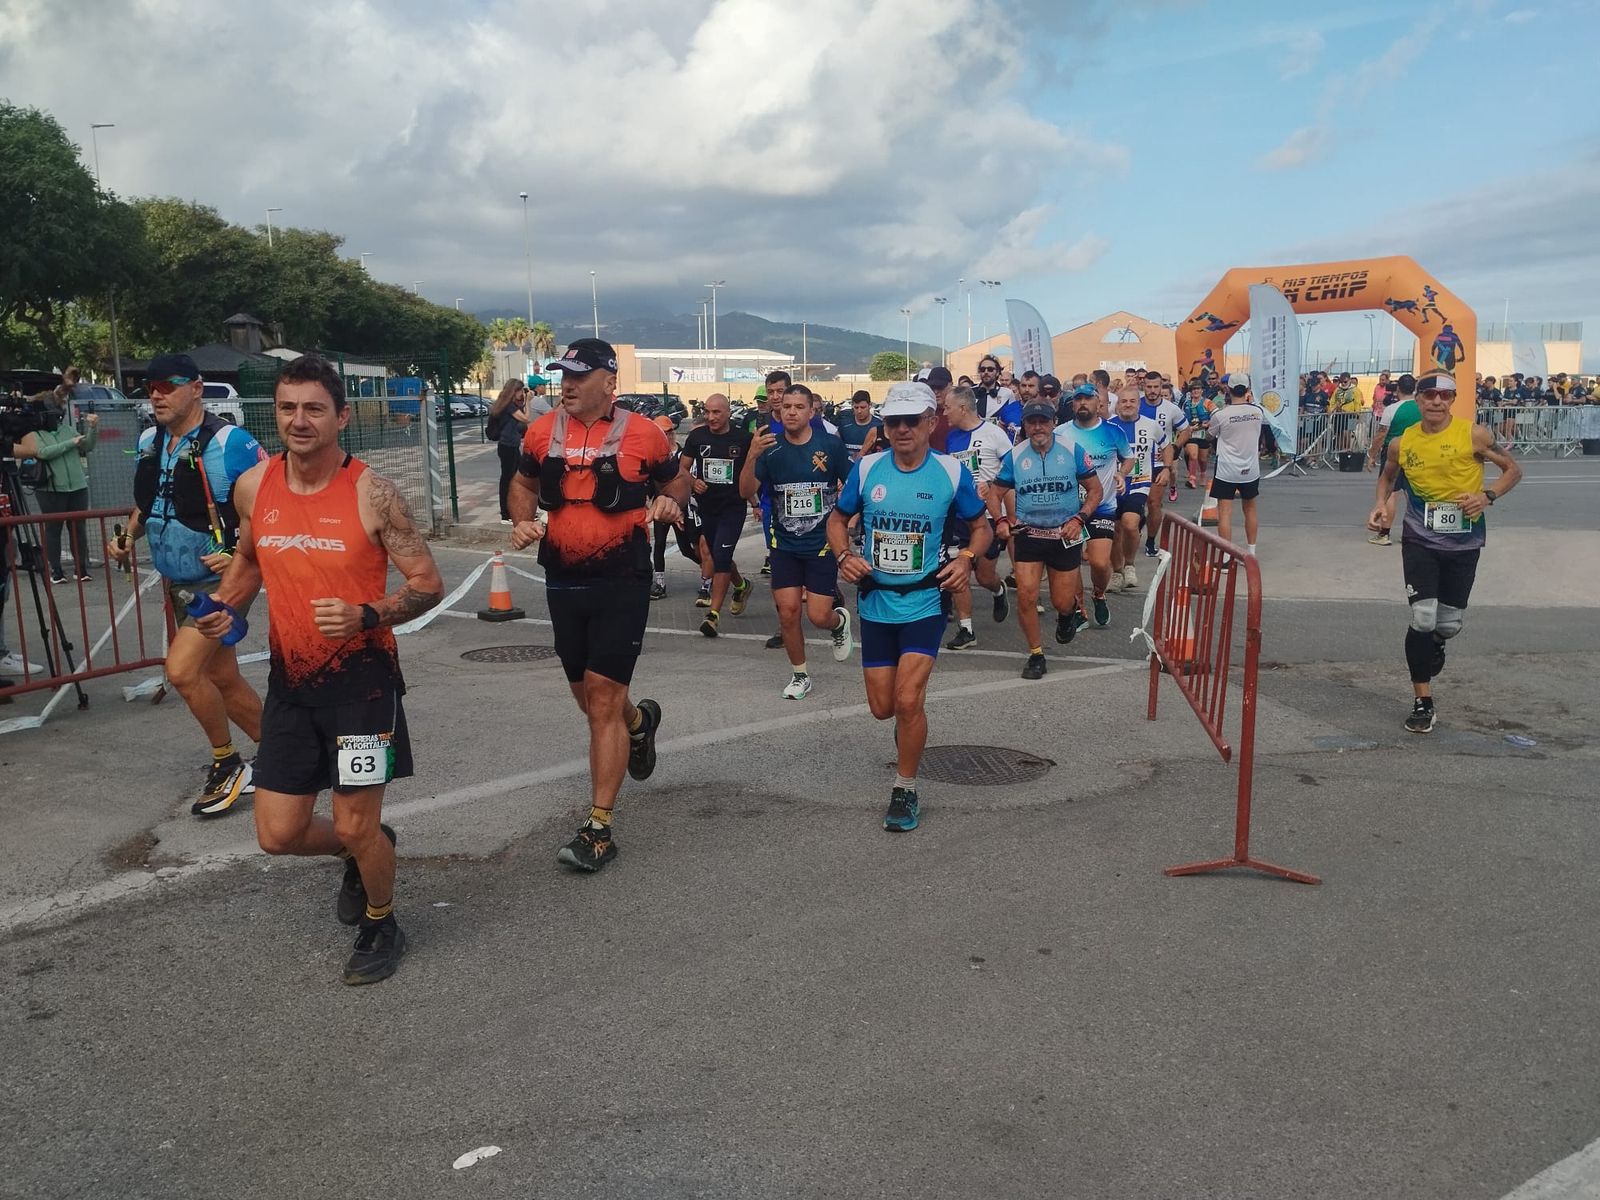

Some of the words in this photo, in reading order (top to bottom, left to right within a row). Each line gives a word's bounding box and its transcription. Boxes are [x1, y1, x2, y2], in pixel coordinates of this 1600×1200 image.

[1283, 277, 1307, 288] MIS
[1310, 270, 1369, 285] TIEMPOS
[1305, 280, 1367, 302] CHIP
[712, 467, 722, 475] 96
[1019, 481, 1073, 494] ANYERA
[793, 499, 812, 509] 216
[1031, 494, 1060, 504] CEUTA
[874, 509, 887, 517] club
[898, 512, 930, 520] montaña
[1440, 514, 1456, 524] 80
[871, 516, 932, 534] ANYERA
[882, 548, 908, 562] 115
[342, 742, 353, 750] LA
[350, 756, 376, 774] 63
